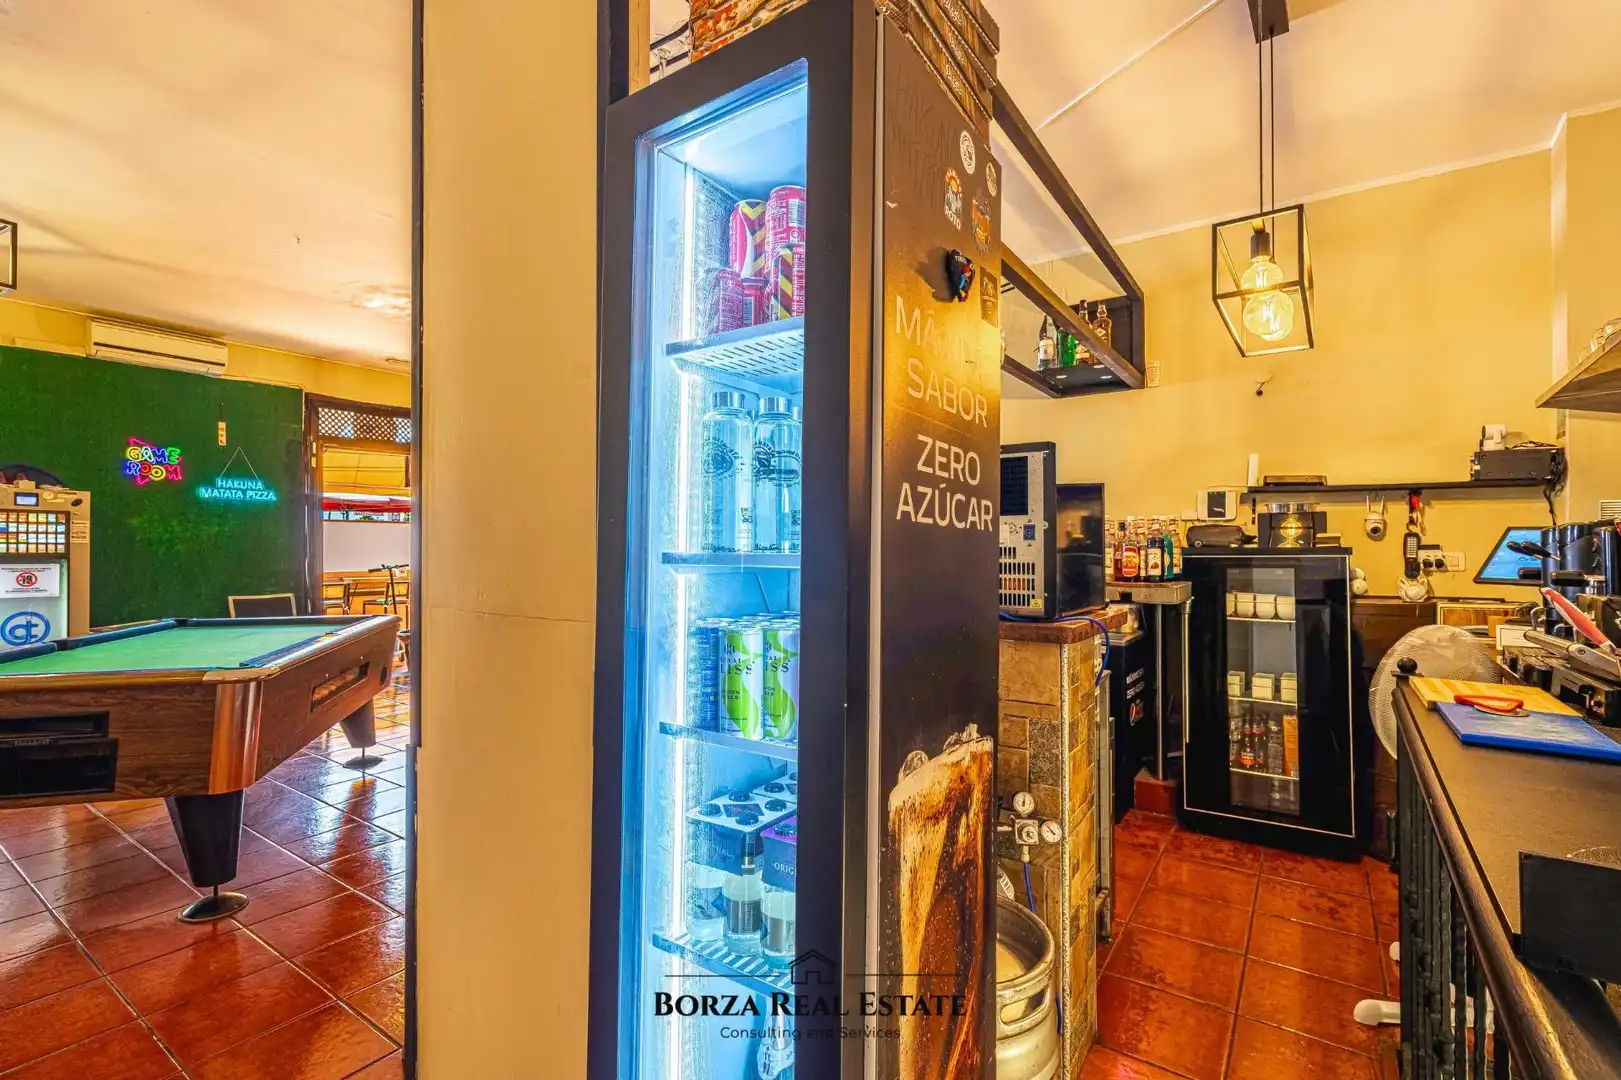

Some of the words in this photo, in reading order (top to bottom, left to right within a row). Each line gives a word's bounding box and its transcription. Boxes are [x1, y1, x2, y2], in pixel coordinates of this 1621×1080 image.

[907, 357, 988, 428] SABOR
[126, 446, 181, 465] GAME
[916, 433, 981, 486] ZERO
[126, 460, 182, 481] ROOM
[200, 487, 242, 498] MATATA
[246, 489, 277, 500] PIZZA
[216, 478, 264, 490] HAKUNA
[896, 482, 993, 532] AZÚCAR
